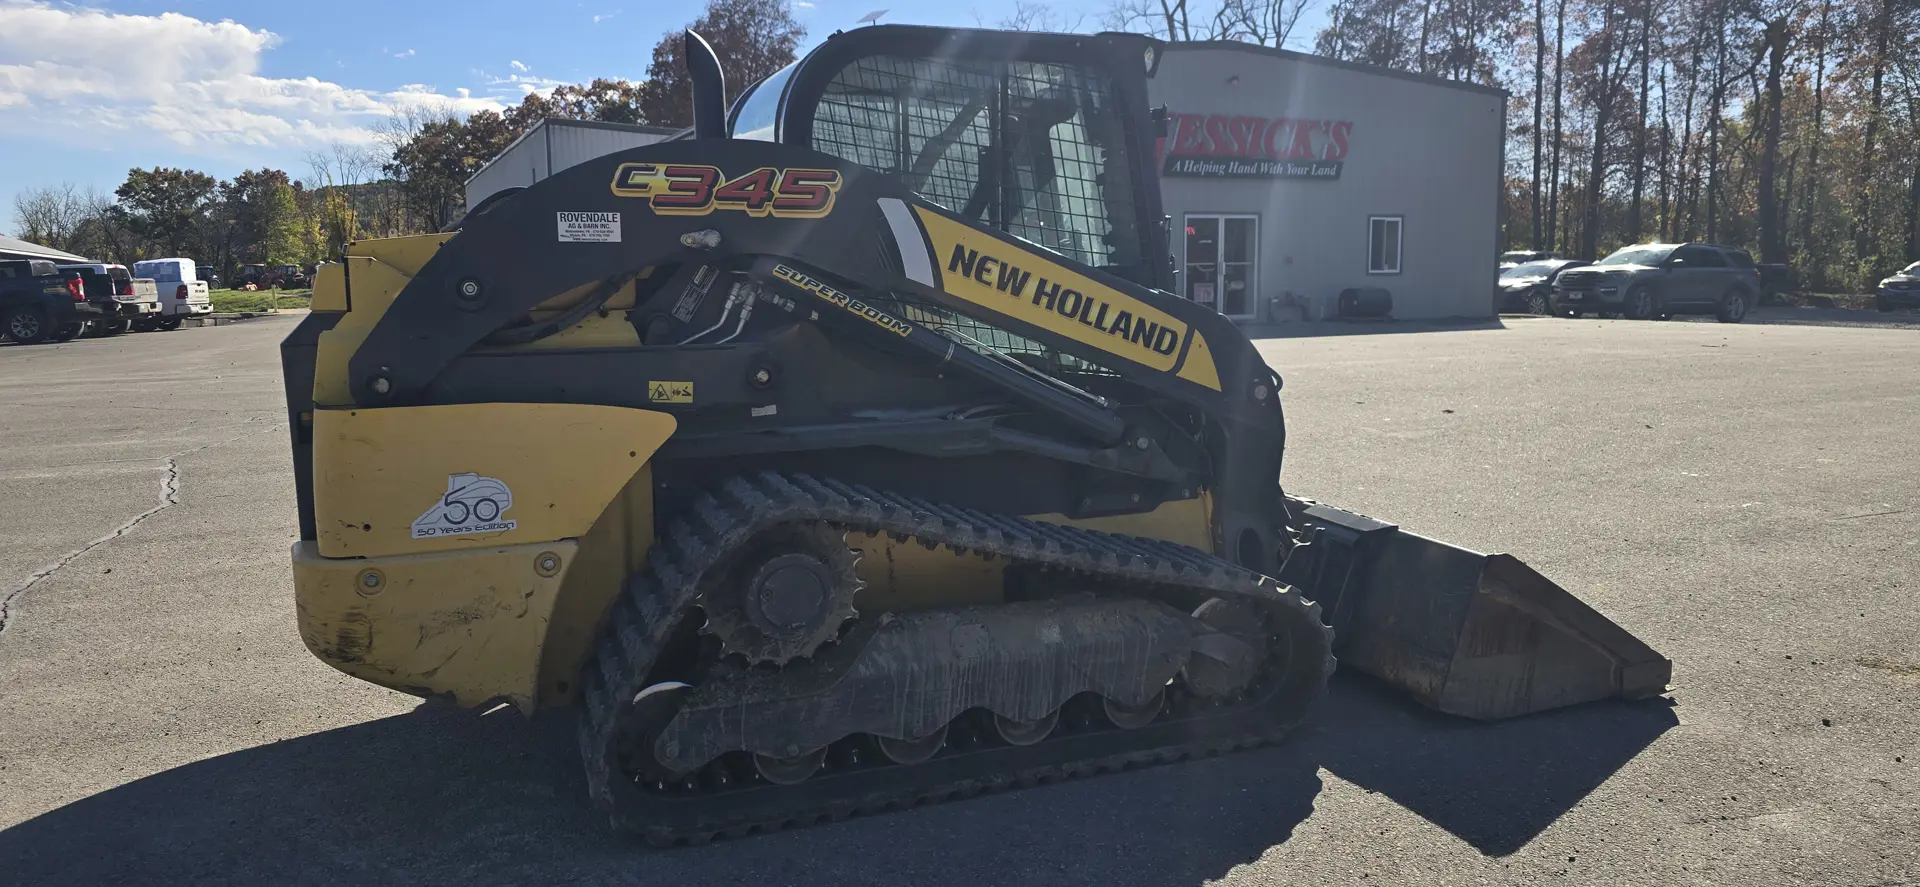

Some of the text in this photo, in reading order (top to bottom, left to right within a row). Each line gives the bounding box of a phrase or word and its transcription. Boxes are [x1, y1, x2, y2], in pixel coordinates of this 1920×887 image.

[1172, 160, 1336, 176] A Helping Hand With Your Land
[611, 163, 842, 217] C345
[560, 212, 619, 223] ROVENDALE
[773, 264, 912, 337] SUPER BOOM
[947, 243, 1179, 356] NEW HOLLAND
[443, 486, 500, 525] 50
[417, 522, 515, 537] 50 Years Edition
